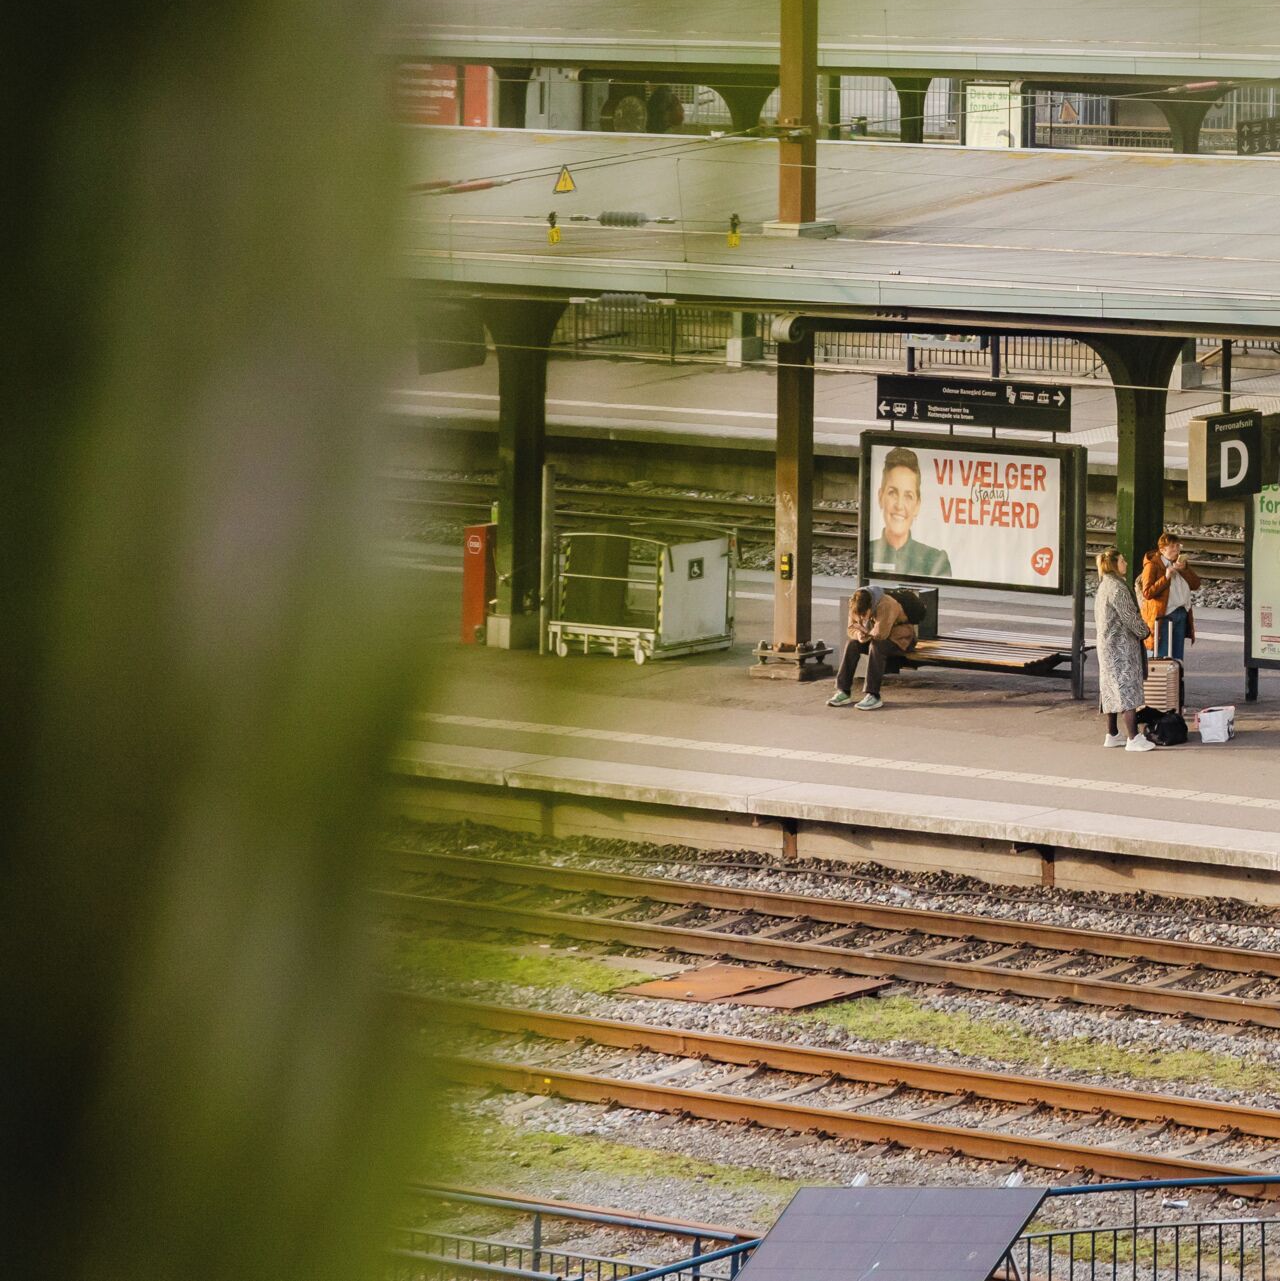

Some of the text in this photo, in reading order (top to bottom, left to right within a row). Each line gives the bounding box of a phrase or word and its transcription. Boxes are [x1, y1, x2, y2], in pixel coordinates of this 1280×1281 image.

[1214, 419, 1253, 432] Perronafsnit
[932, 458, 1047, 492] VI VÆLGER
[1220, 440, 1249, 489] D
[940, 497, 1040, 529] VELFÆRD
[1034, 552, 1051, 569] SF
